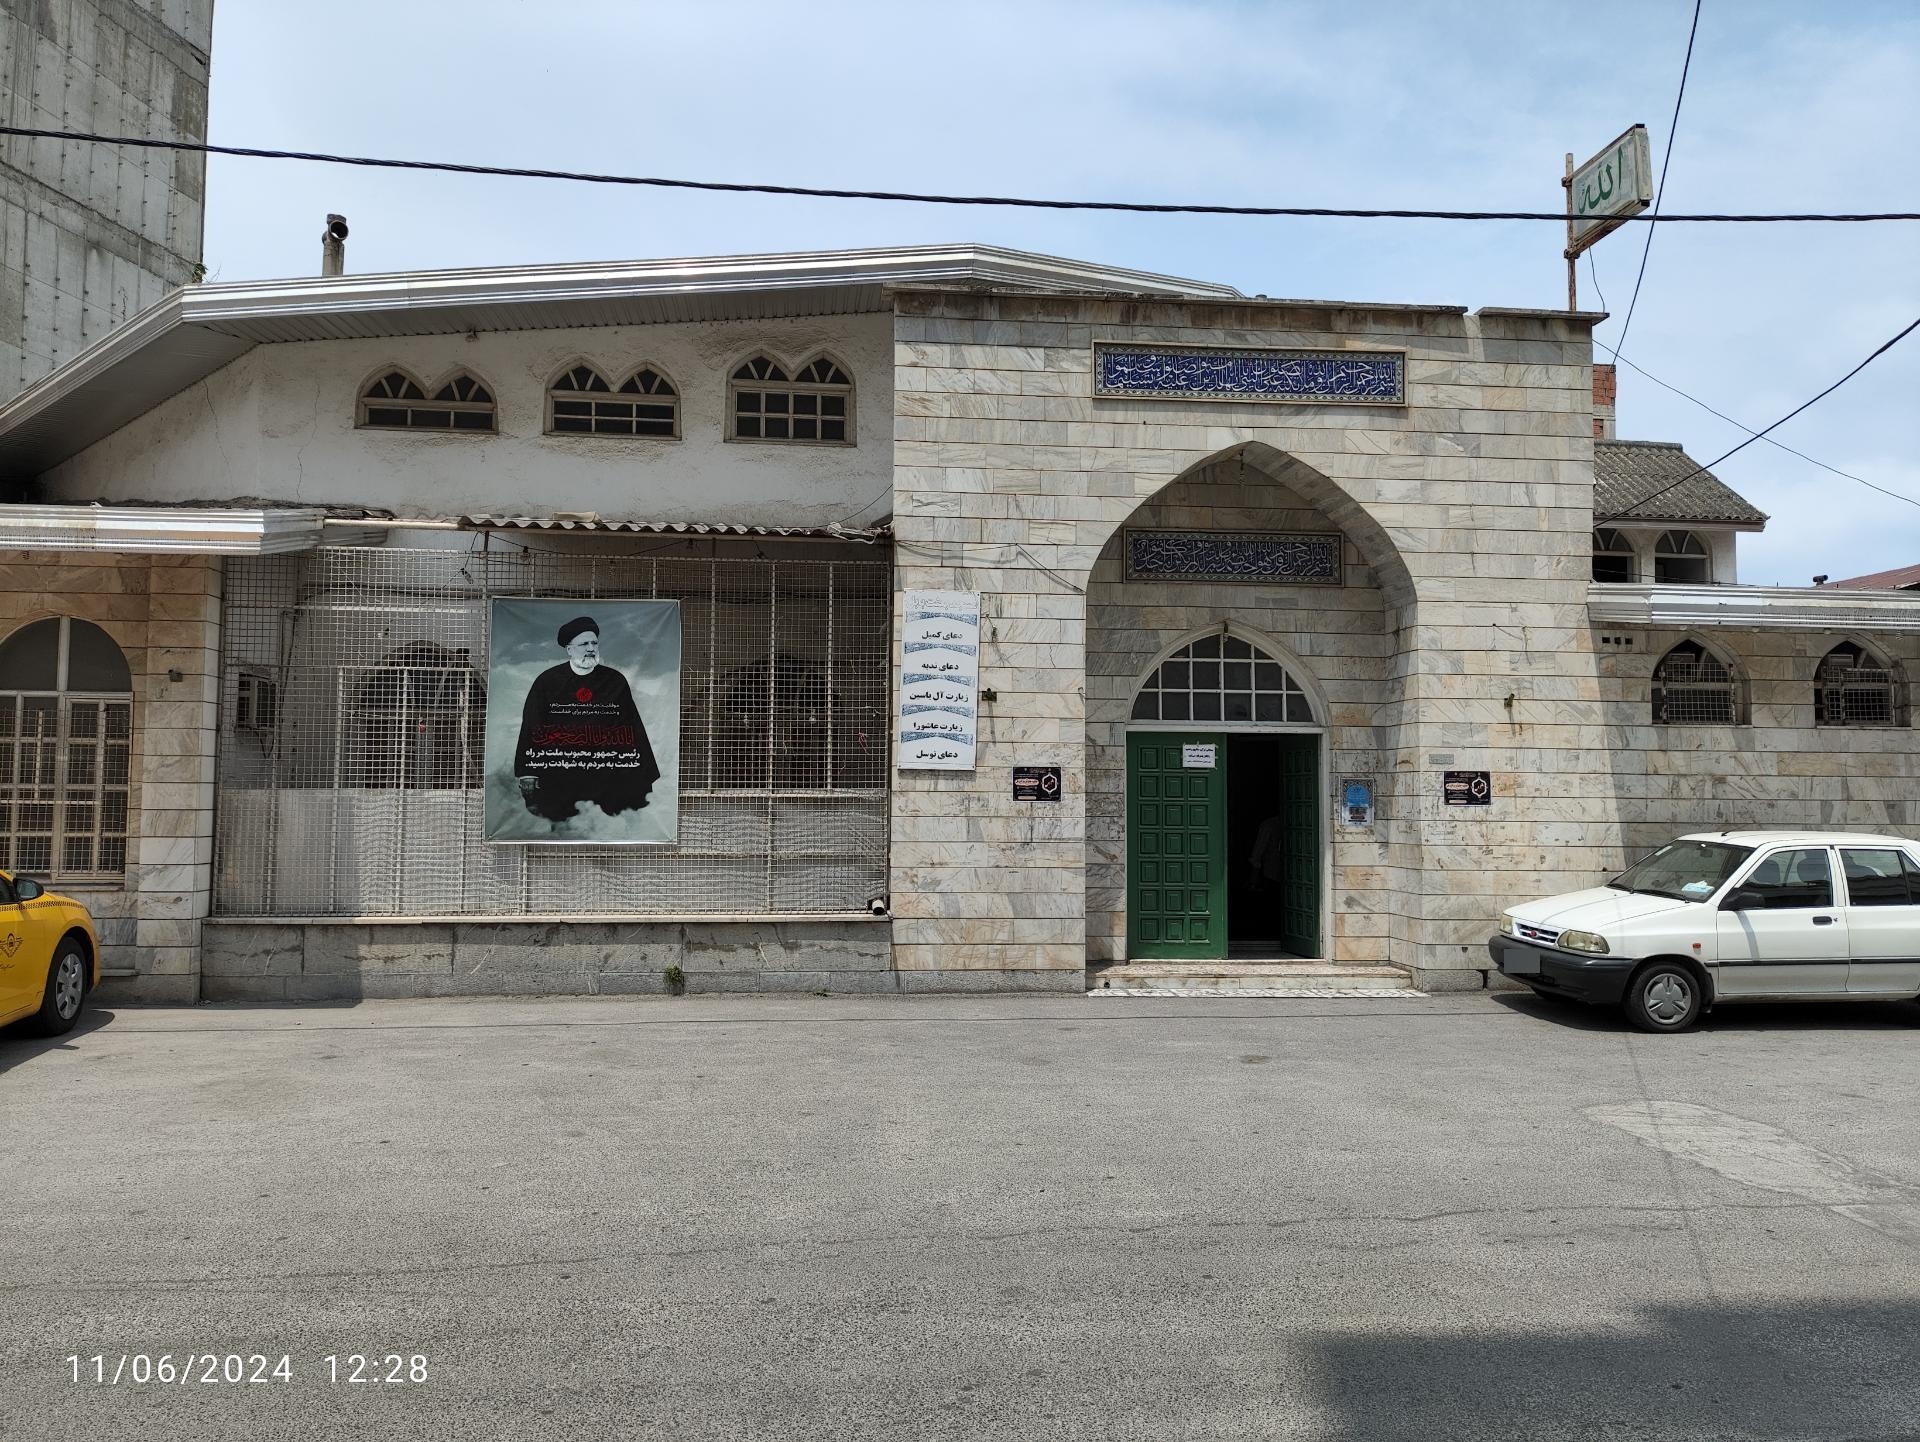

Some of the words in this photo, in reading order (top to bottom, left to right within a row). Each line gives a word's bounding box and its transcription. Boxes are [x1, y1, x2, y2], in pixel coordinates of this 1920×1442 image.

[1578, 146, 1623, 214] الله
[921, 631, 942, 640] کمیل
[943, 631, 963, 640] دعای
[939, 662, 959, 672] دعای
[909, 691, 932, 700] یاسین
[945, 692, 969, 702] زیارت
[913, 722, 939, 731] عاشورا
[940, 723, 963, 732] زیارت
[525, 748, 536, 758] راه
[536, 749, 545, 758] در
[545, 748, 563, 757] ملت
[564, 750, 592, 759] محبوب
[592, 750, 618, 759] جمهور
[618, 748, 640, 759] رئیس
[937, 750, 959, 760] دعای
[548, 758, 578, 768] شهادت
[578, 761, 586, 770] به
[586, 760, 605, 770] مردم
[607, 761, 614, 769] به
[614, 759, 640, 768] خدمت
